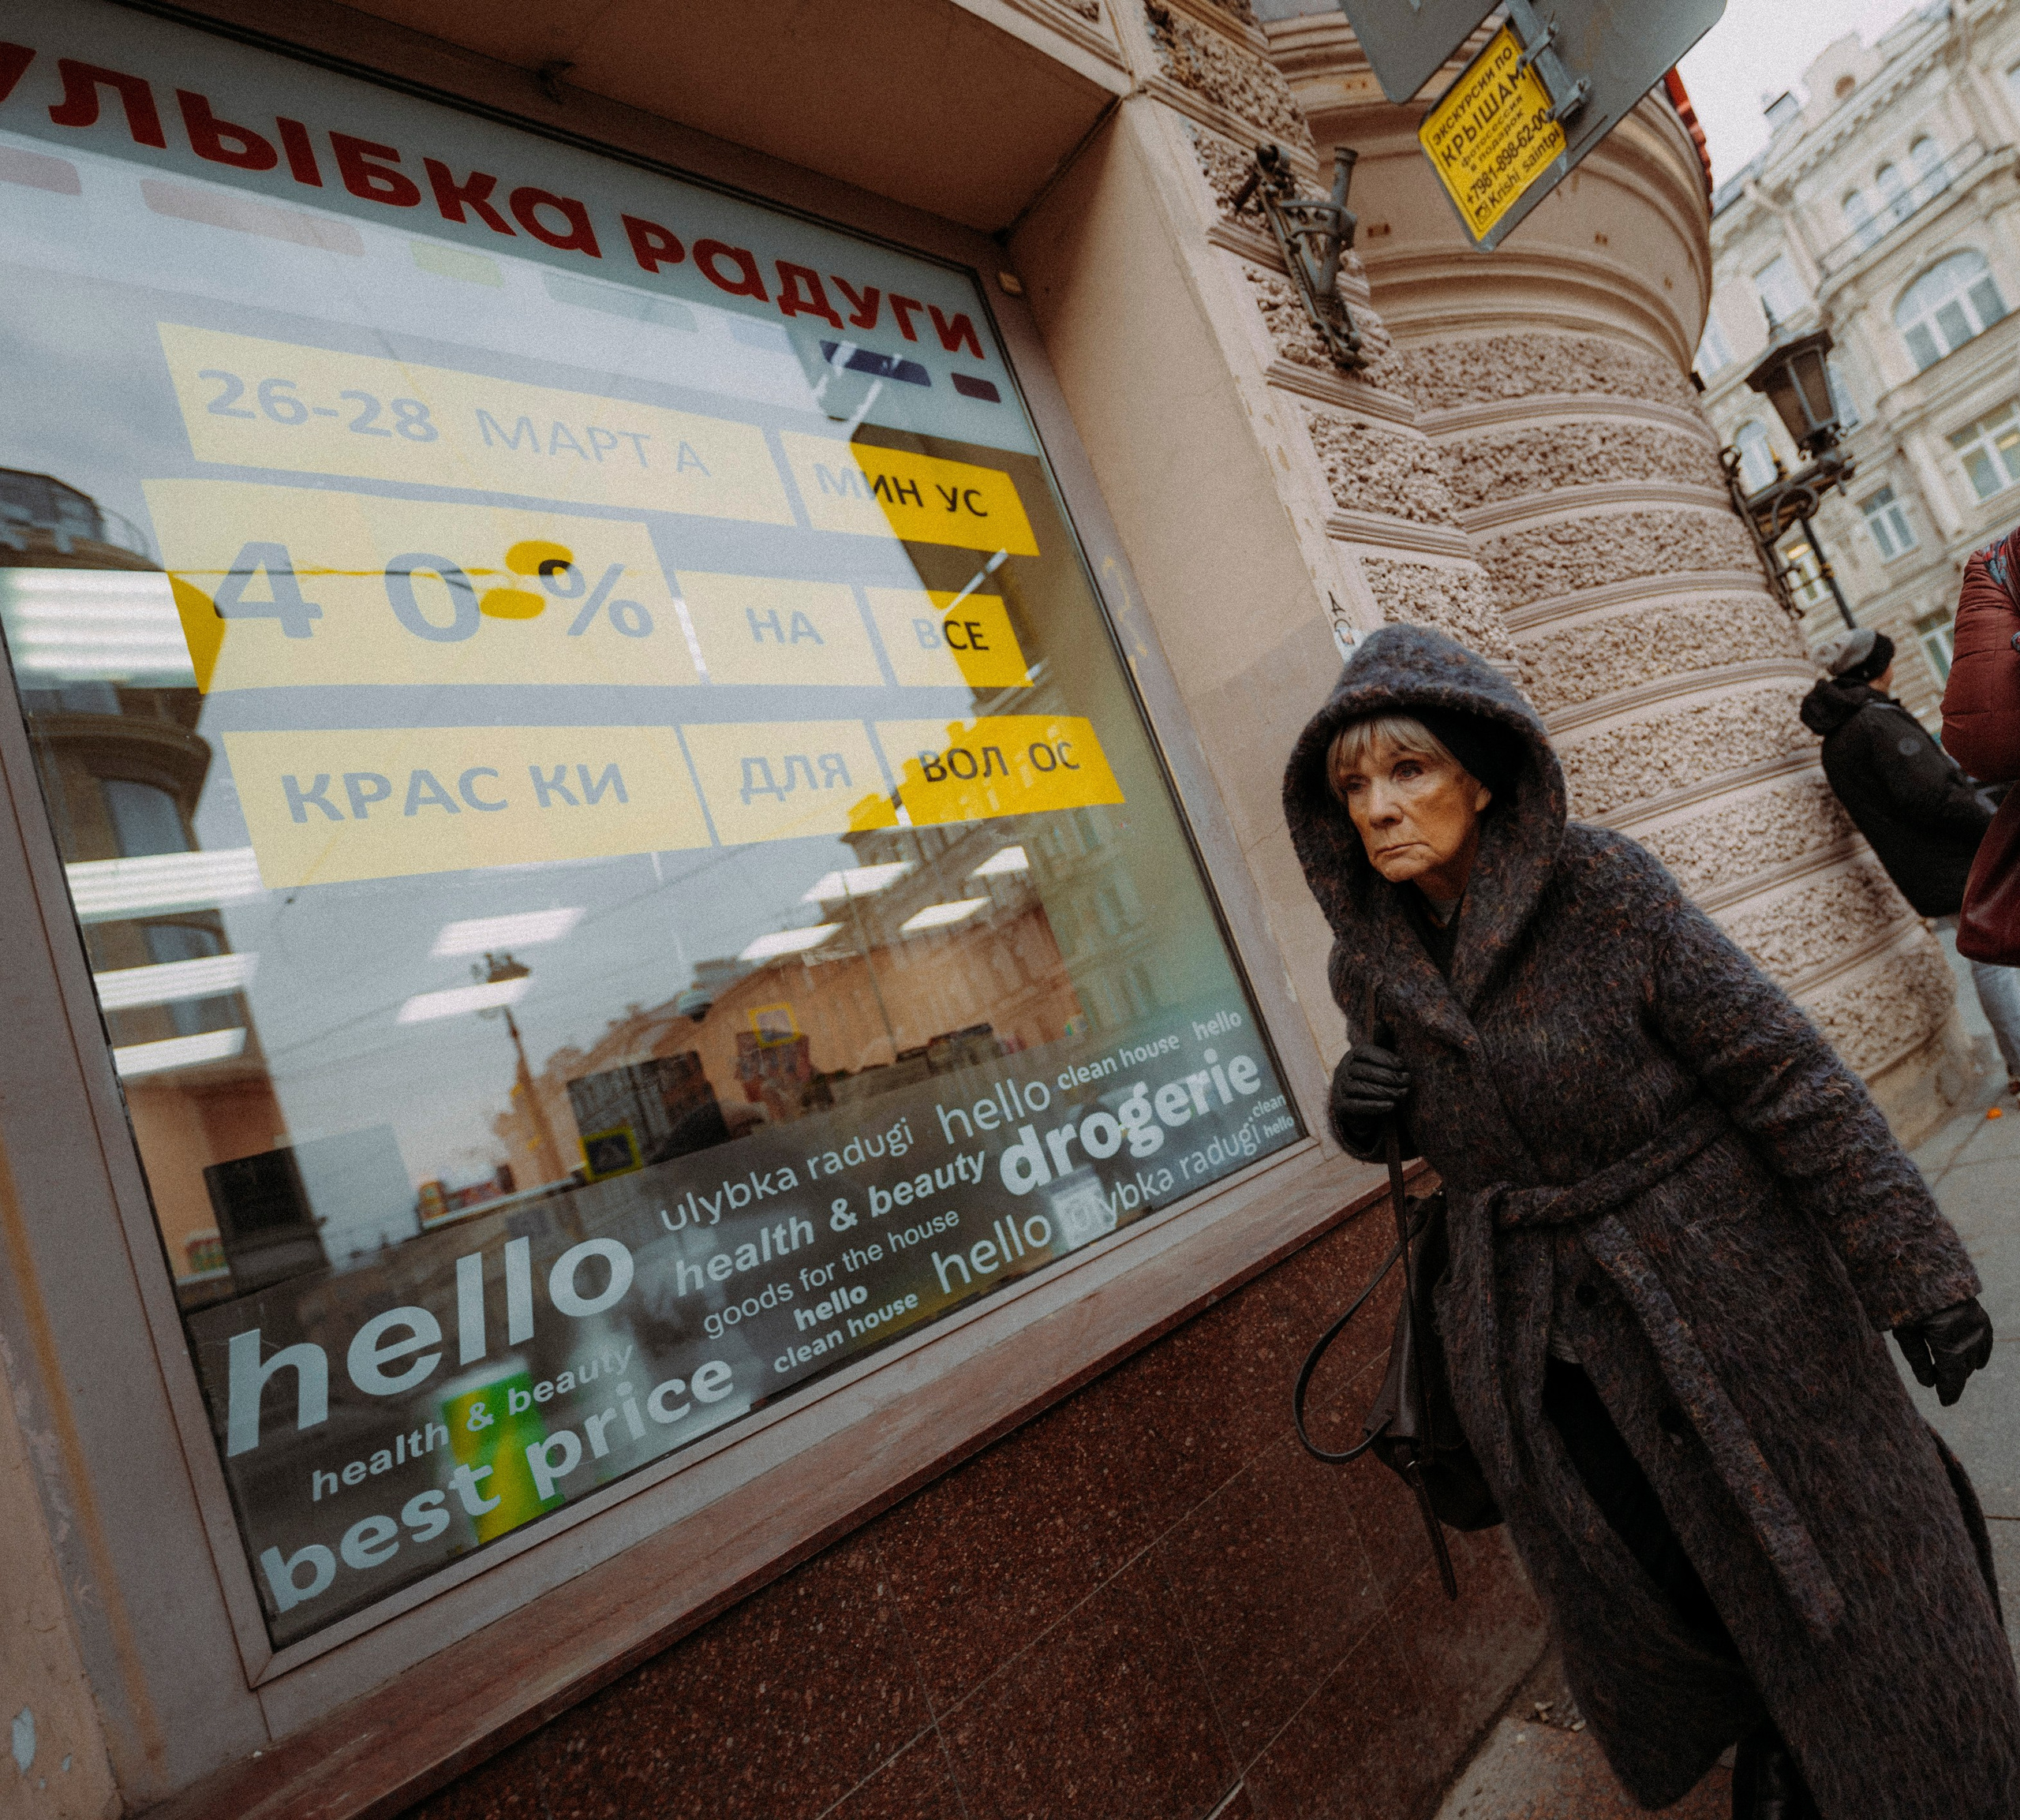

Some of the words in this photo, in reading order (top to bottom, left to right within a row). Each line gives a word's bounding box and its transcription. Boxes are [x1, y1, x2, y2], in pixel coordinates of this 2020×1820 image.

[1432, 67, 1495, 146] ЭКСКУРСИИ
[1494, 47, 1513, 71] ПО
[1441, 66, 1526, 168] КРЫШАМ
[197, 369, 440, 444] 26-28
[746, 607, 824, 647] НА
[911, 617, 990, 652] ВСЕ
[739, 751, 853, 806] ДЛЯ
[1057, 1056, 1118, 1091] clean
[1118, 1034, 1180, 1068] house
[1191, 1010, 1242, 1041] hello
[936, 1078, 1051, 1145] hello
[999, 1048, 1261, 1196] drogerie
[1252, 1093, 1287, 1119] clean
[1262, 1115, 1295, 1138] hello
[660, 1166, 799, 1231] ulybka
[806, 1116, 915, 1181] radugi
[1072, 1168, 1174, 1228] ybka
[1179, 1116, 1261, 1180] radugi
[675, 1216, 815, 1298] health
[829, 1197, 859, 1233] &
[869, 1150, 986, 1218] beauty
[930, 1214, 1052, 1295] hello
[703, 1280, 794, 1340] goods
[799, 1262, 836, 1292] for
[841, 1242, 884, 1273] the
[887, 1209, 960, 1254] house
[793, 1285, 868, 1332] hello
[226, 1235, 634, 1457] hello
[773, 1329, 844, 1374] clean
[847, 1292, 919, 1339] house
[312, 1421, 451, 1501] health
[466, 1403, 494, 1432] &
[508, 1344, 633, 1416] beauty
[259, 1461, 501, 1613] best
[525, 1359, 734, 1500] price
